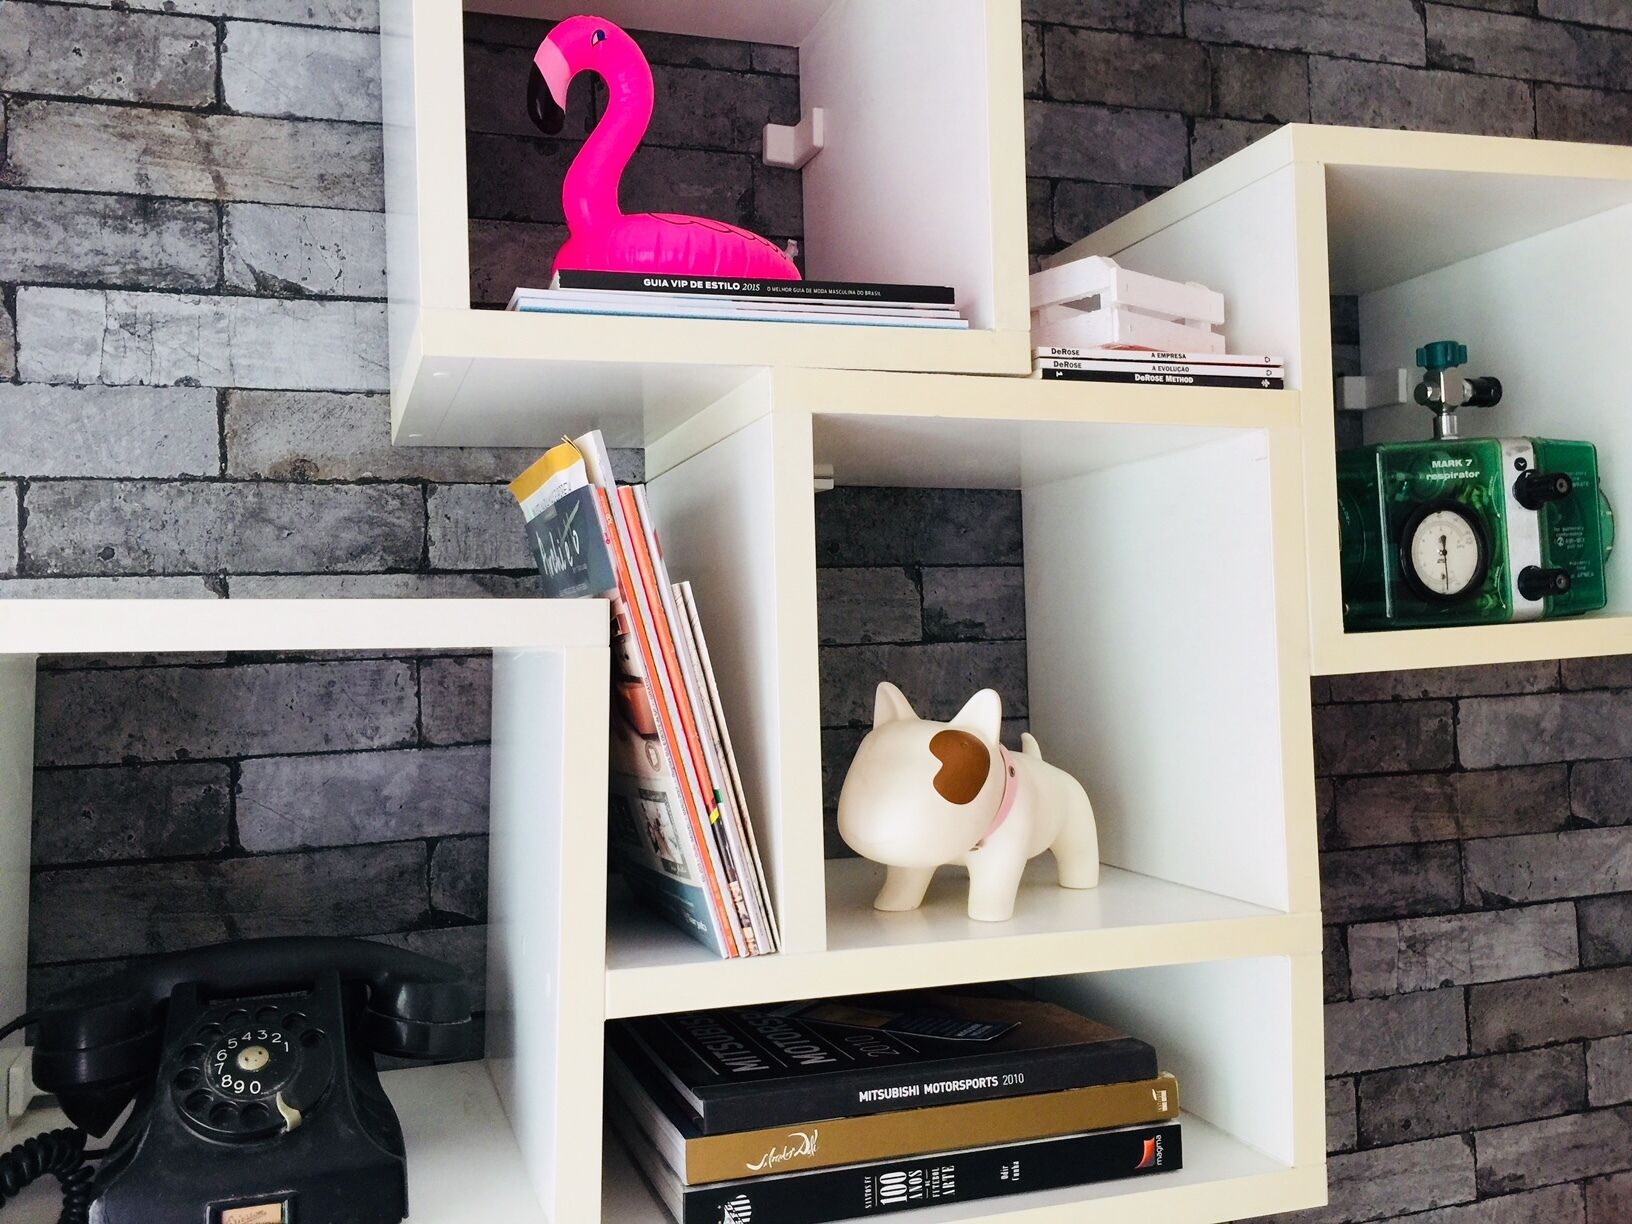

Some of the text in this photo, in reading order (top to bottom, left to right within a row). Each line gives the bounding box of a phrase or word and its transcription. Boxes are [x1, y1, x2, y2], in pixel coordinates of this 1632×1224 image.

[643, 278, 760, 291] GUIA VIP DE ESTILO 2015
[829, 288, 856, 296] MASCULINA
[1426, 470, 1480, 481] respirator
[1431, 458, 1473, 468] MARK 7
[844, 1033, 900, 1057] 2010
[214, 1029, 289, 1094] 1 2 3 4 5 6 7 8 9 0
[858, 1072, 1025, 1103] MITSUBISHI MOTORSPORTS 2010
[1155, 1134, 1164, 1166] magma
[879, 1171, 908, 1206] 100
[908, 1169, 923, 1199] ANOS
[931, 1167, 940, 1198] FUTEBOL
[941, 1165, 955, 1196] ARTE
